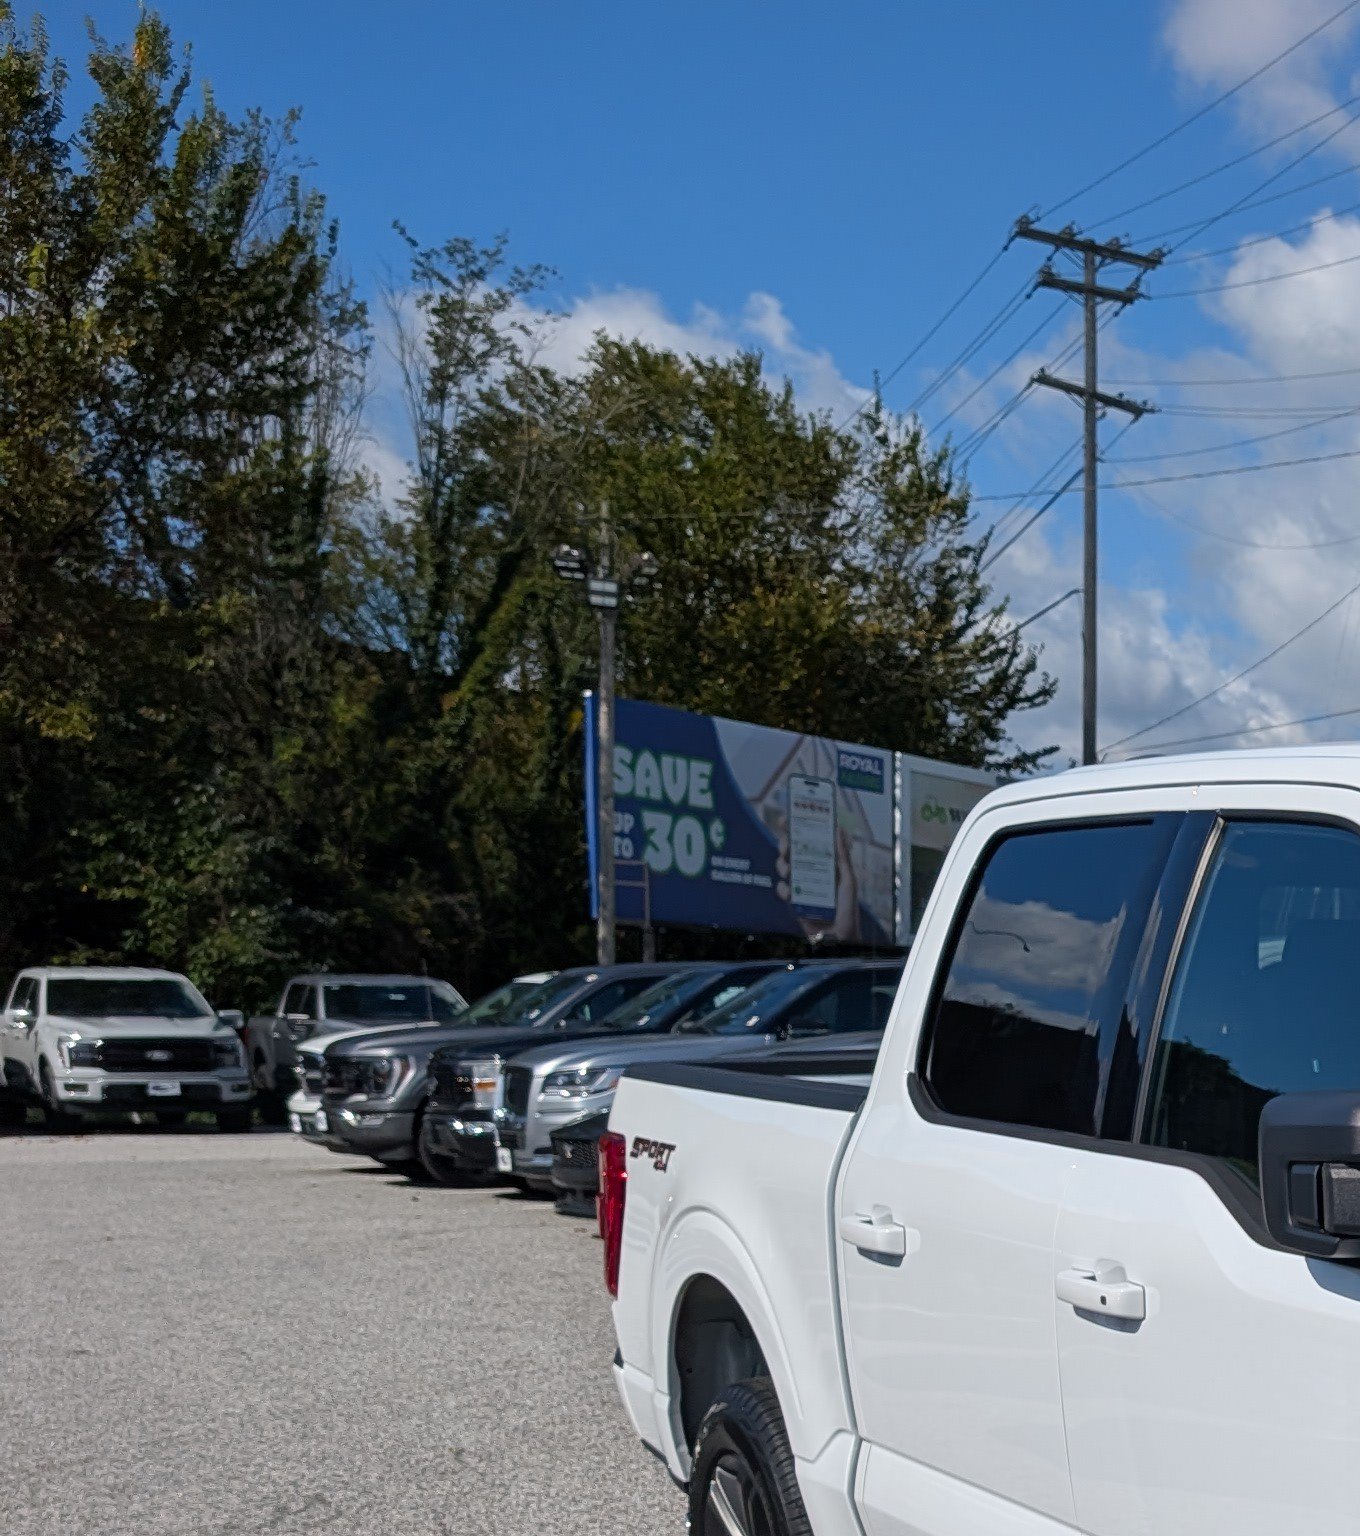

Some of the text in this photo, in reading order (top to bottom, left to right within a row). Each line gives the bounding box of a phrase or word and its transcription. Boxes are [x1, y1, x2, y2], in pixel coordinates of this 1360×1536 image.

[613, 746, 714, 809] SAVE
[839, 754, 882, 775] ROYAL
[629, 1135, 677, 1167] SPORT
